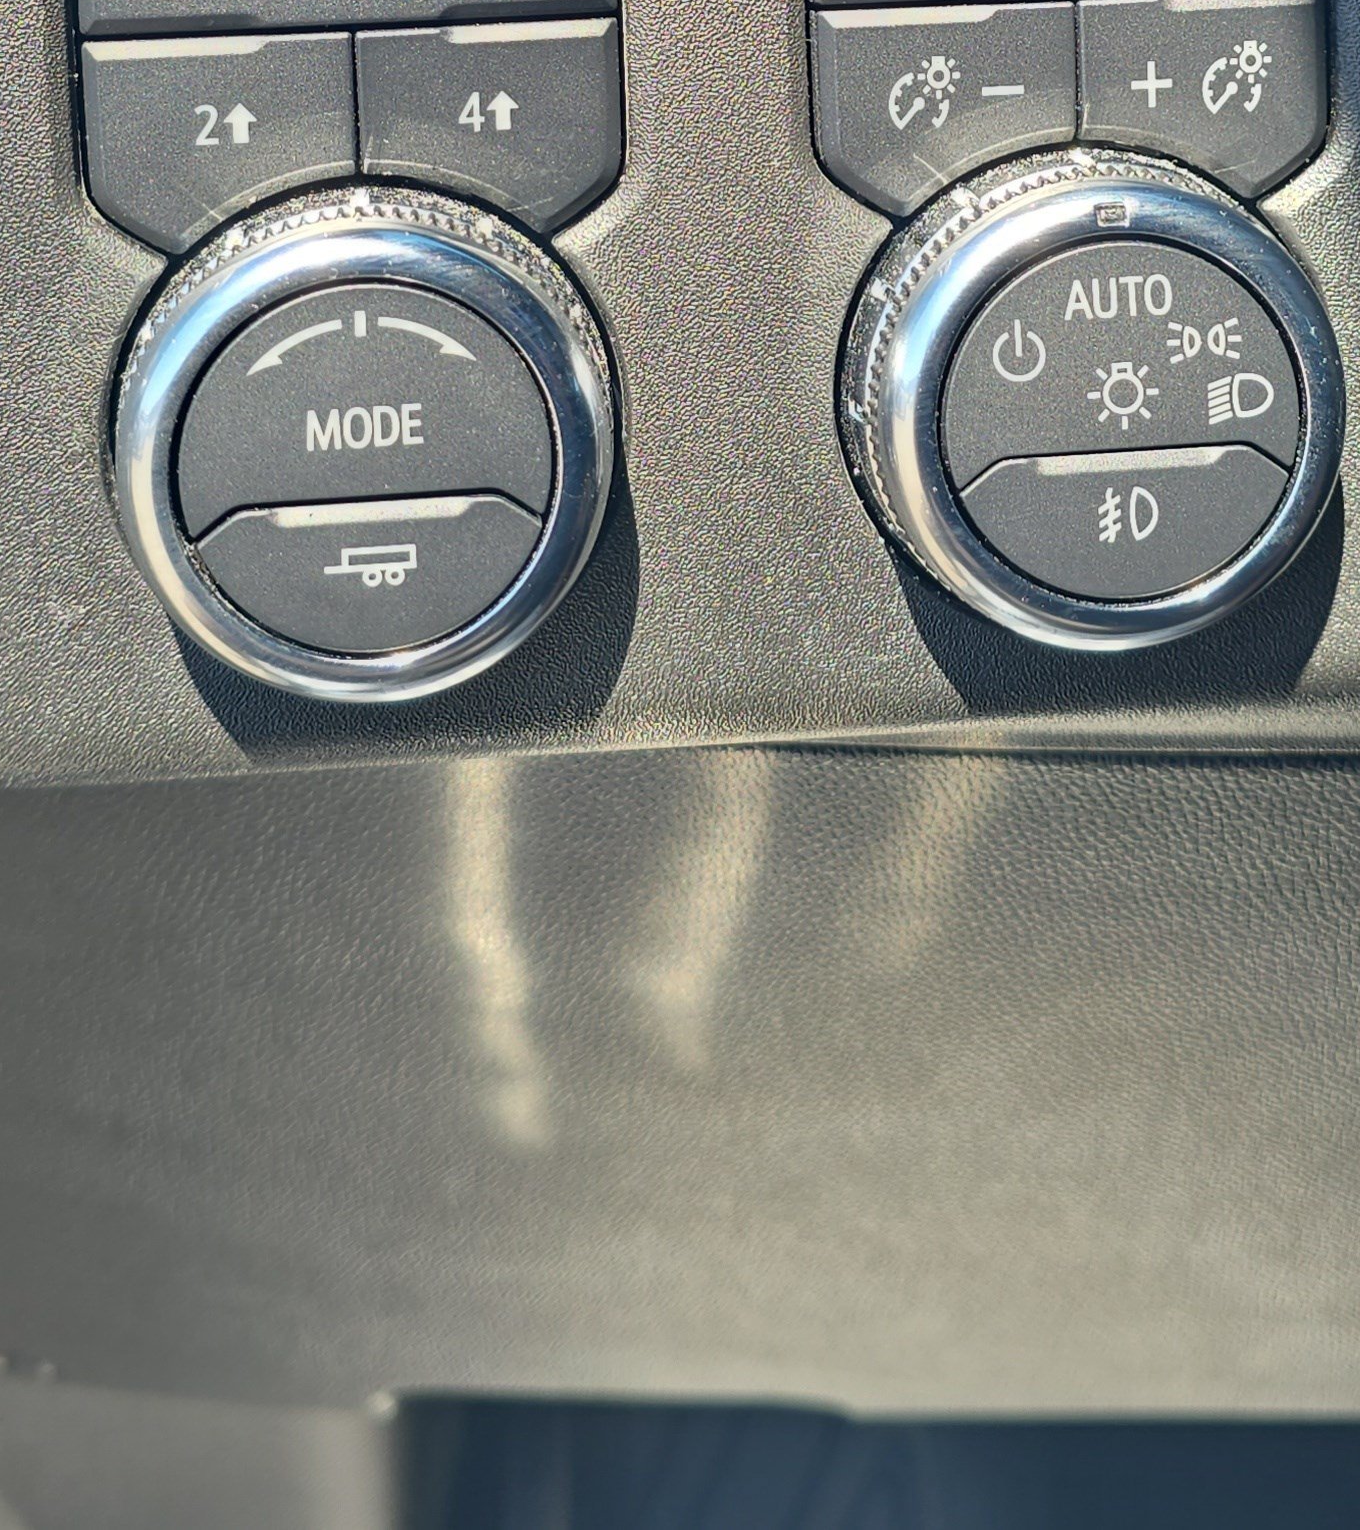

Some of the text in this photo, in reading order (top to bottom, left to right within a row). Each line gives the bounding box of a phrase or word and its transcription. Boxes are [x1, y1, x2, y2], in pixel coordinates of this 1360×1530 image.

[194, 104, 220, 146] 2
[459, 92, 485, 133] 4
[1063, 273, 1173, 321] AUTO
[306, 403, 425, 452] MODE
